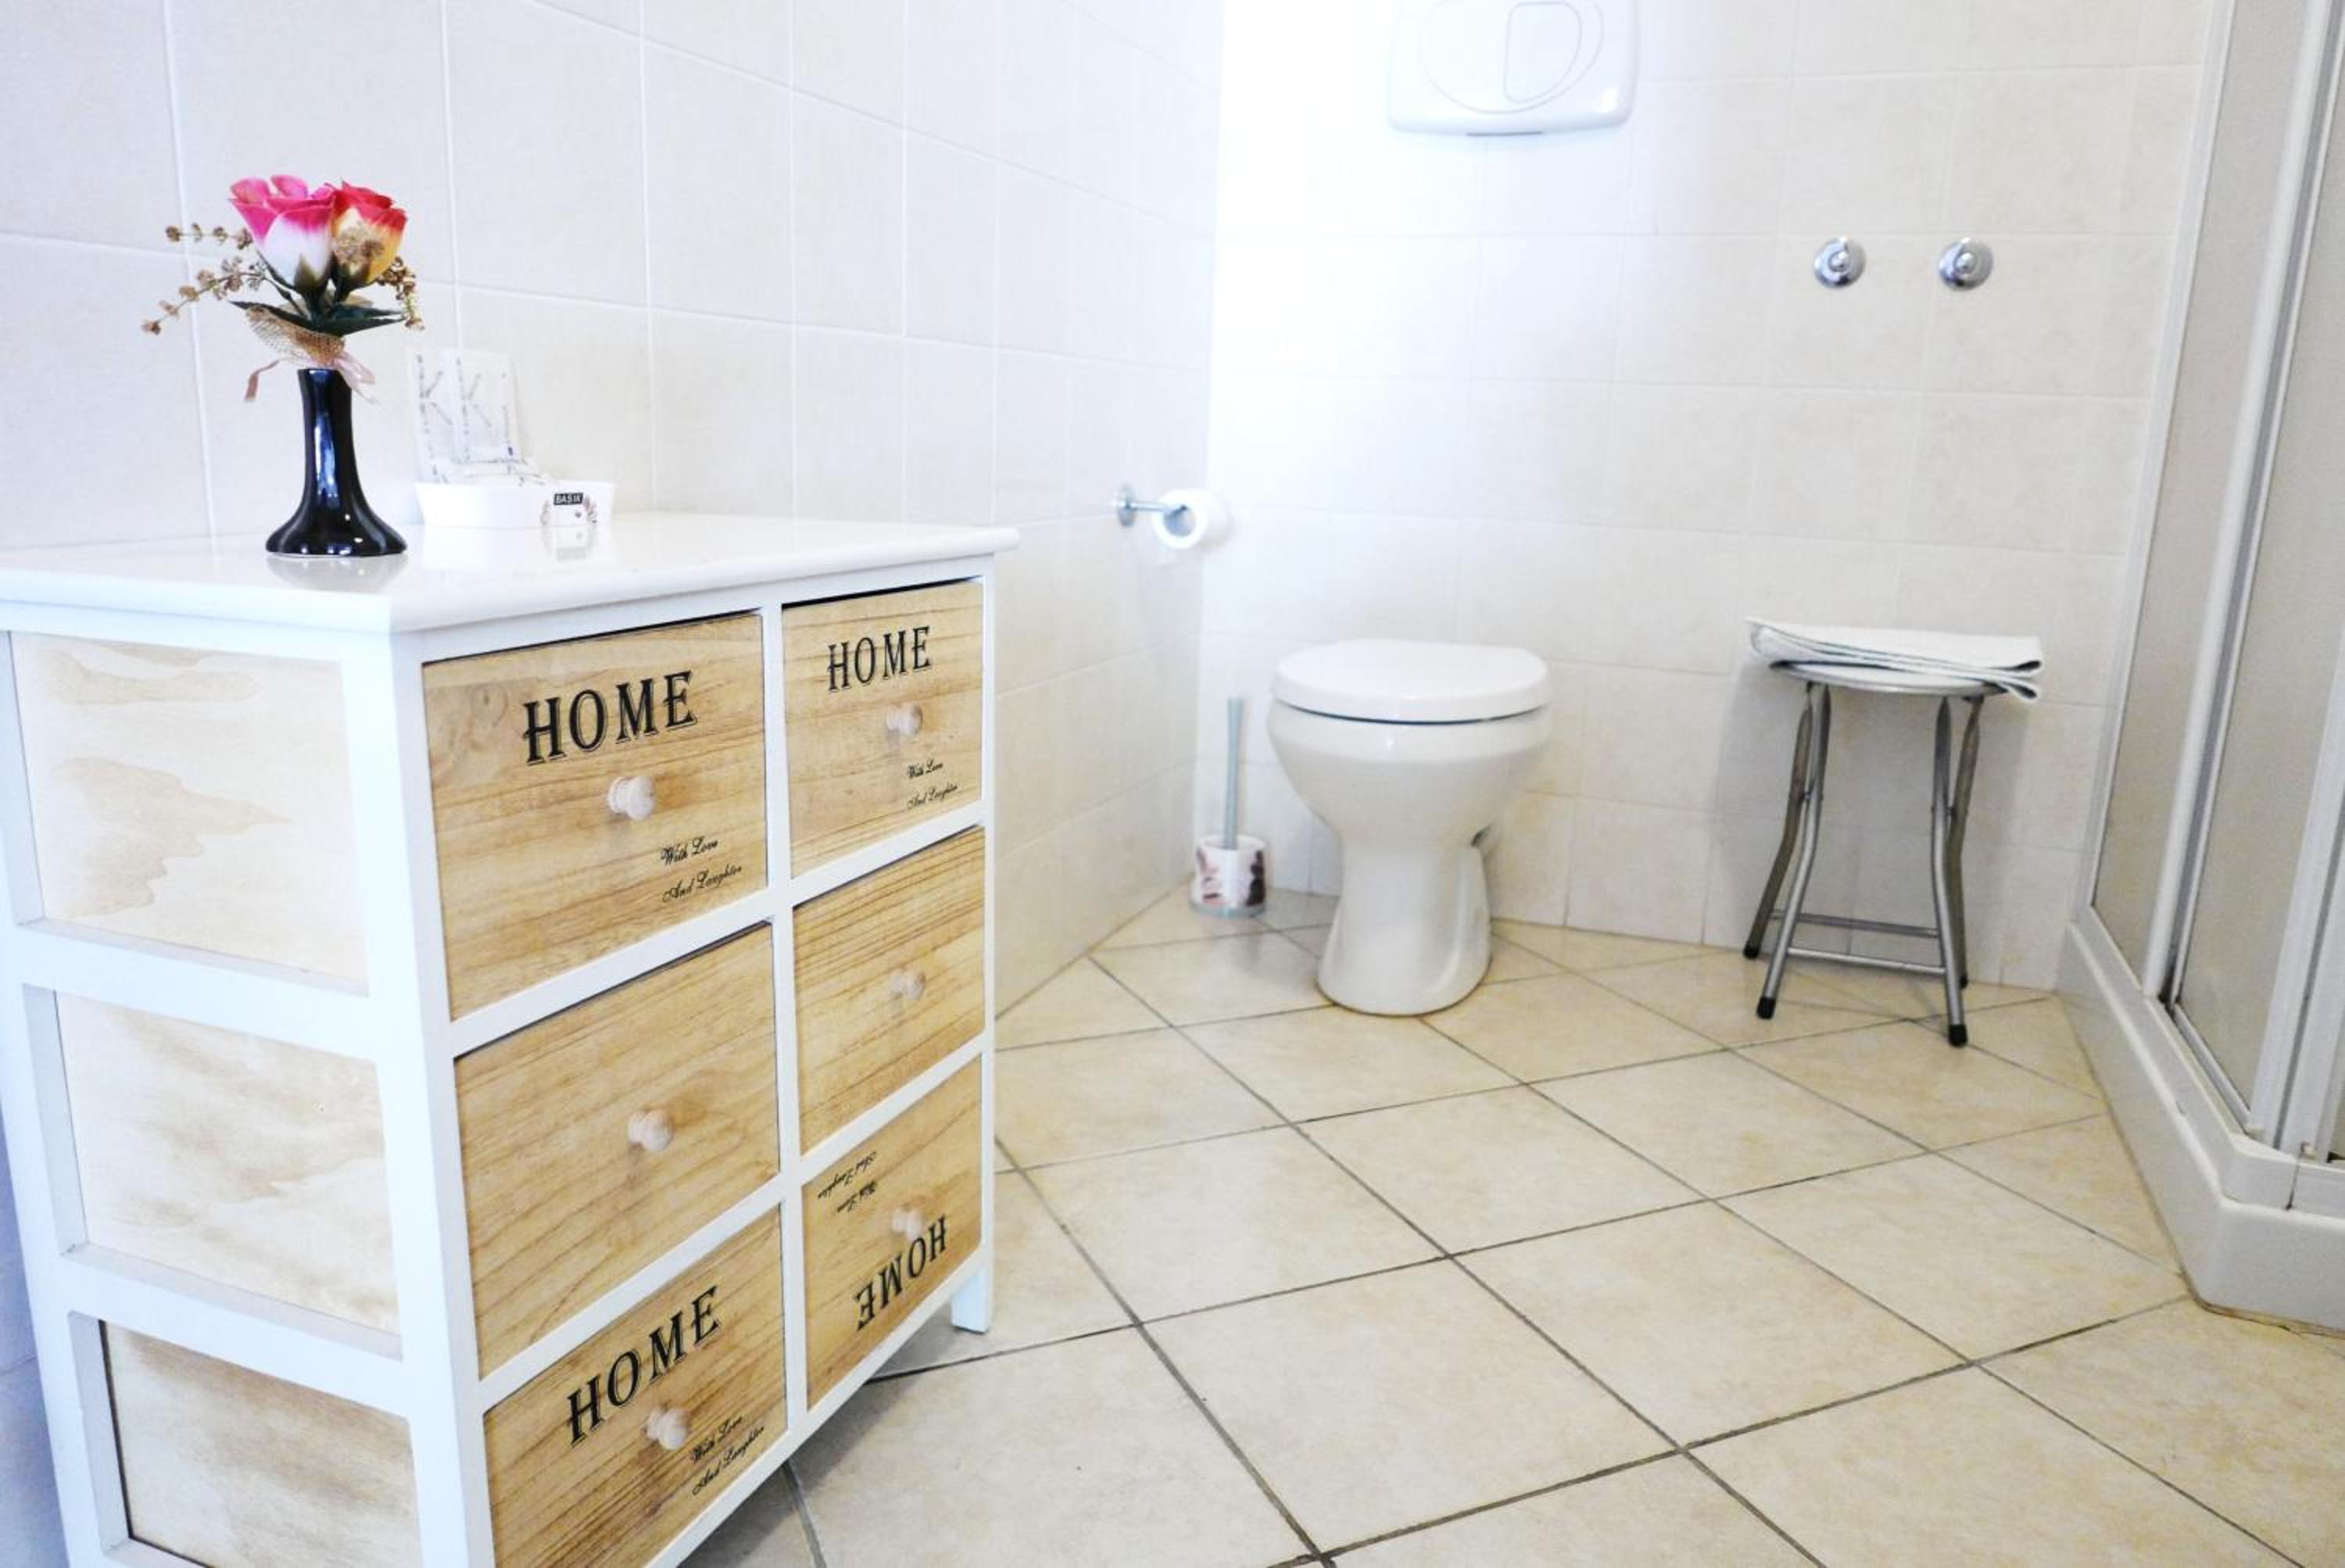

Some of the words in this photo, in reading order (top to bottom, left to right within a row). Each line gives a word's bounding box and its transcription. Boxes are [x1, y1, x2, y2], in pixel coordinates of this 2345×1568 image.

[827, 625, 933, 693] HOME
[522, 670, 698, 766] HOME
[661, 843, 688, 865] With
[691, 835, 718, 855] Love
[663, 877, 695, 902] And
[852, 1213, 947, 1331] HOME
[567, 1284, 721, 1448] HOME
